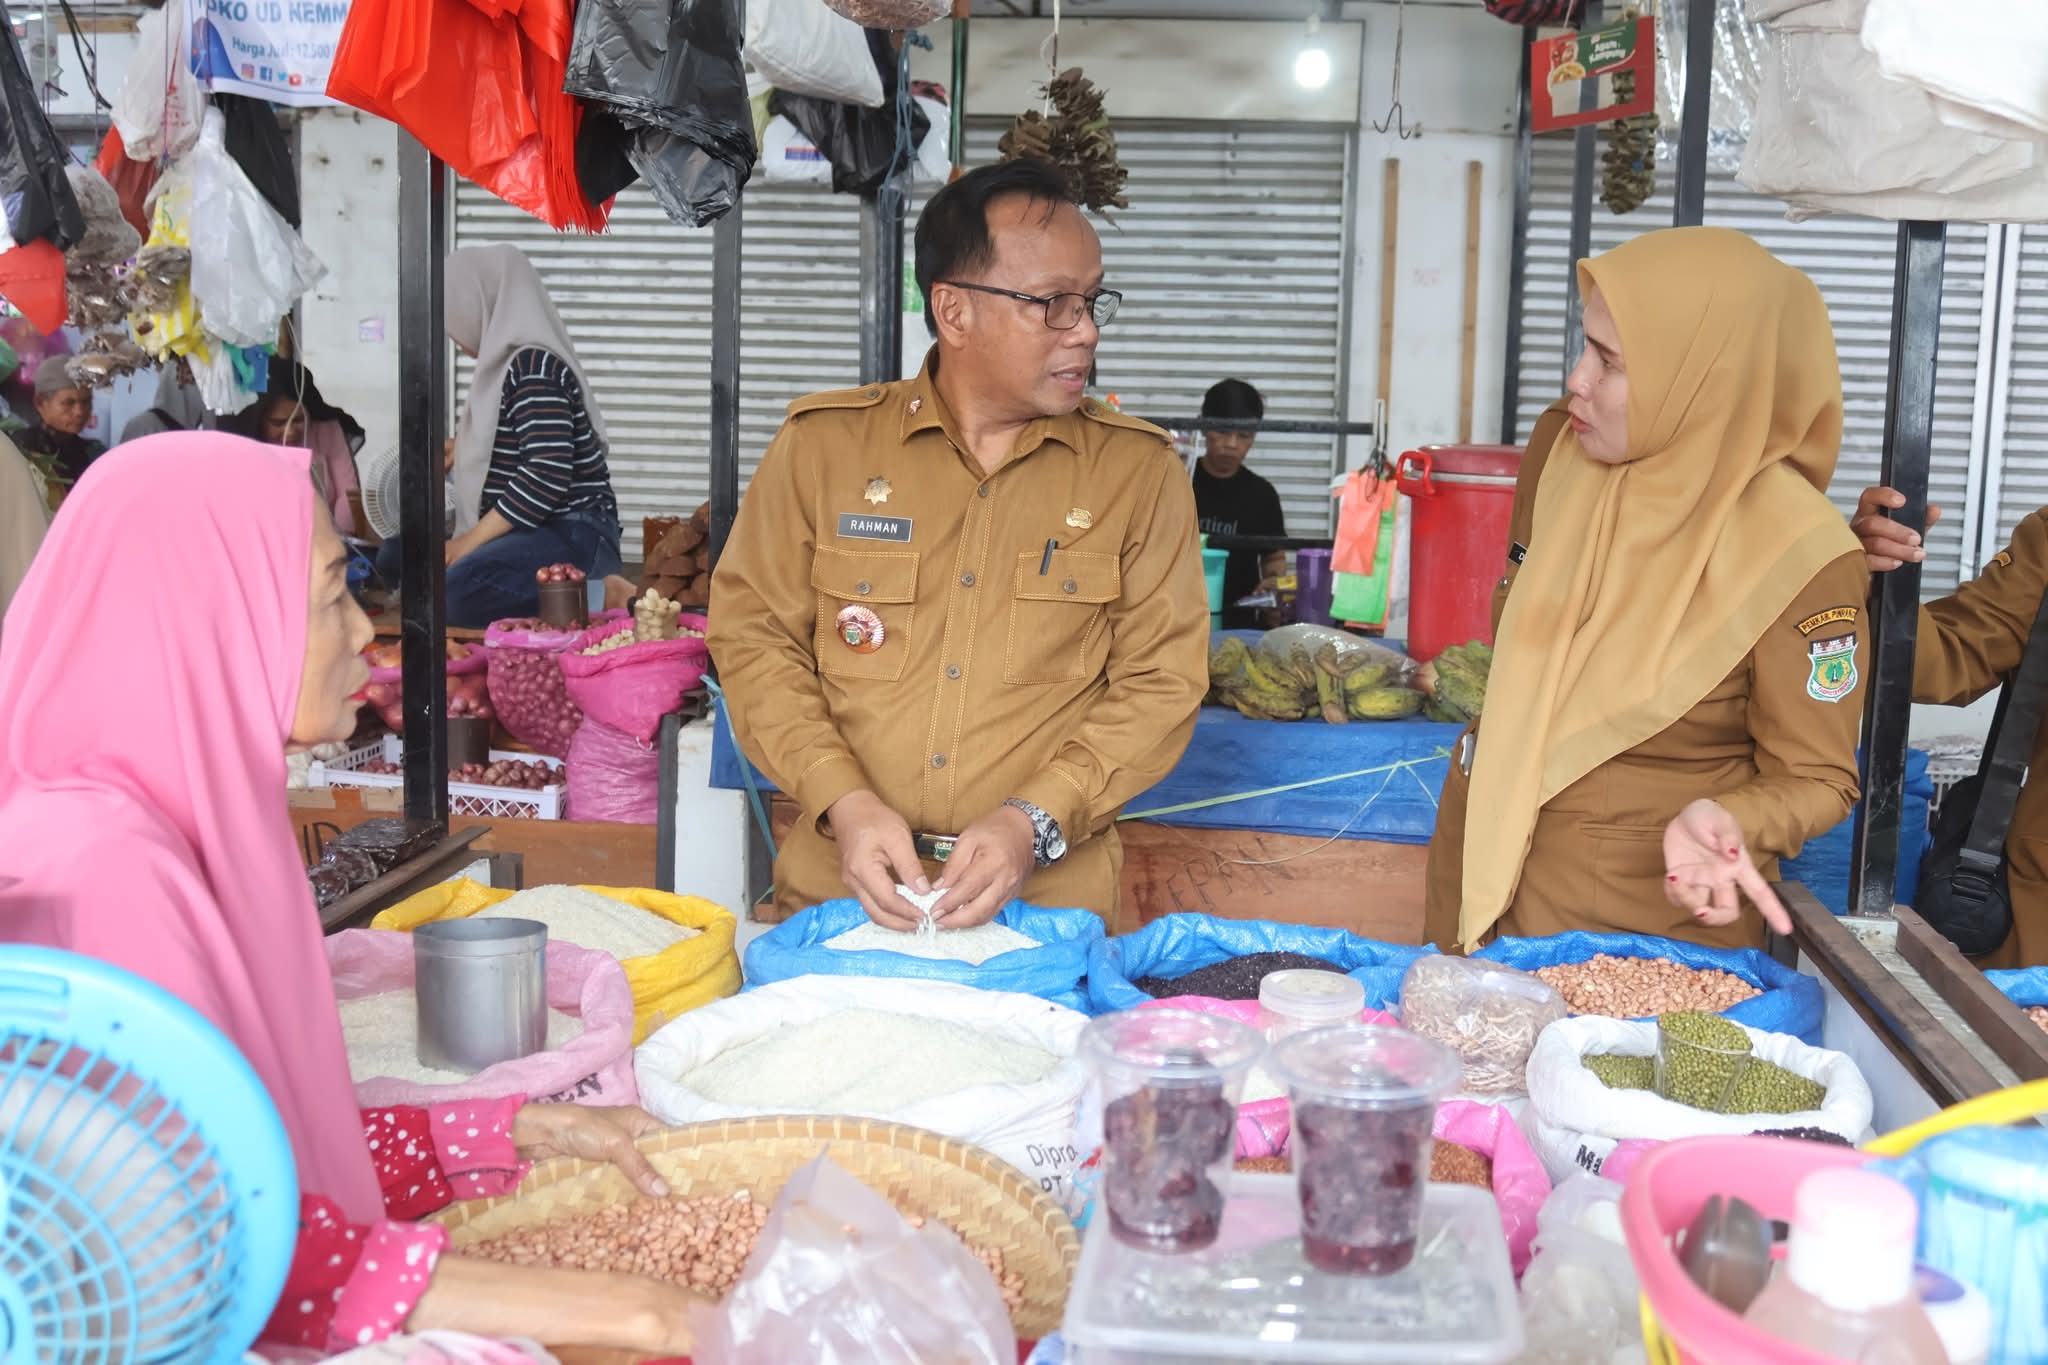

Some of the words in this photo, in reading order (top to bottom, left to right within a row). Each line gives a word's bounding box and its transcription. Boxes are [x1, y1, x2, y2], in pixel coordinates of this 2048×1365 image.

[256, 3, 281, 22] UD
[232, 35, 265, 59] Harga
[850, 519, 898, 534] RAHMAN
